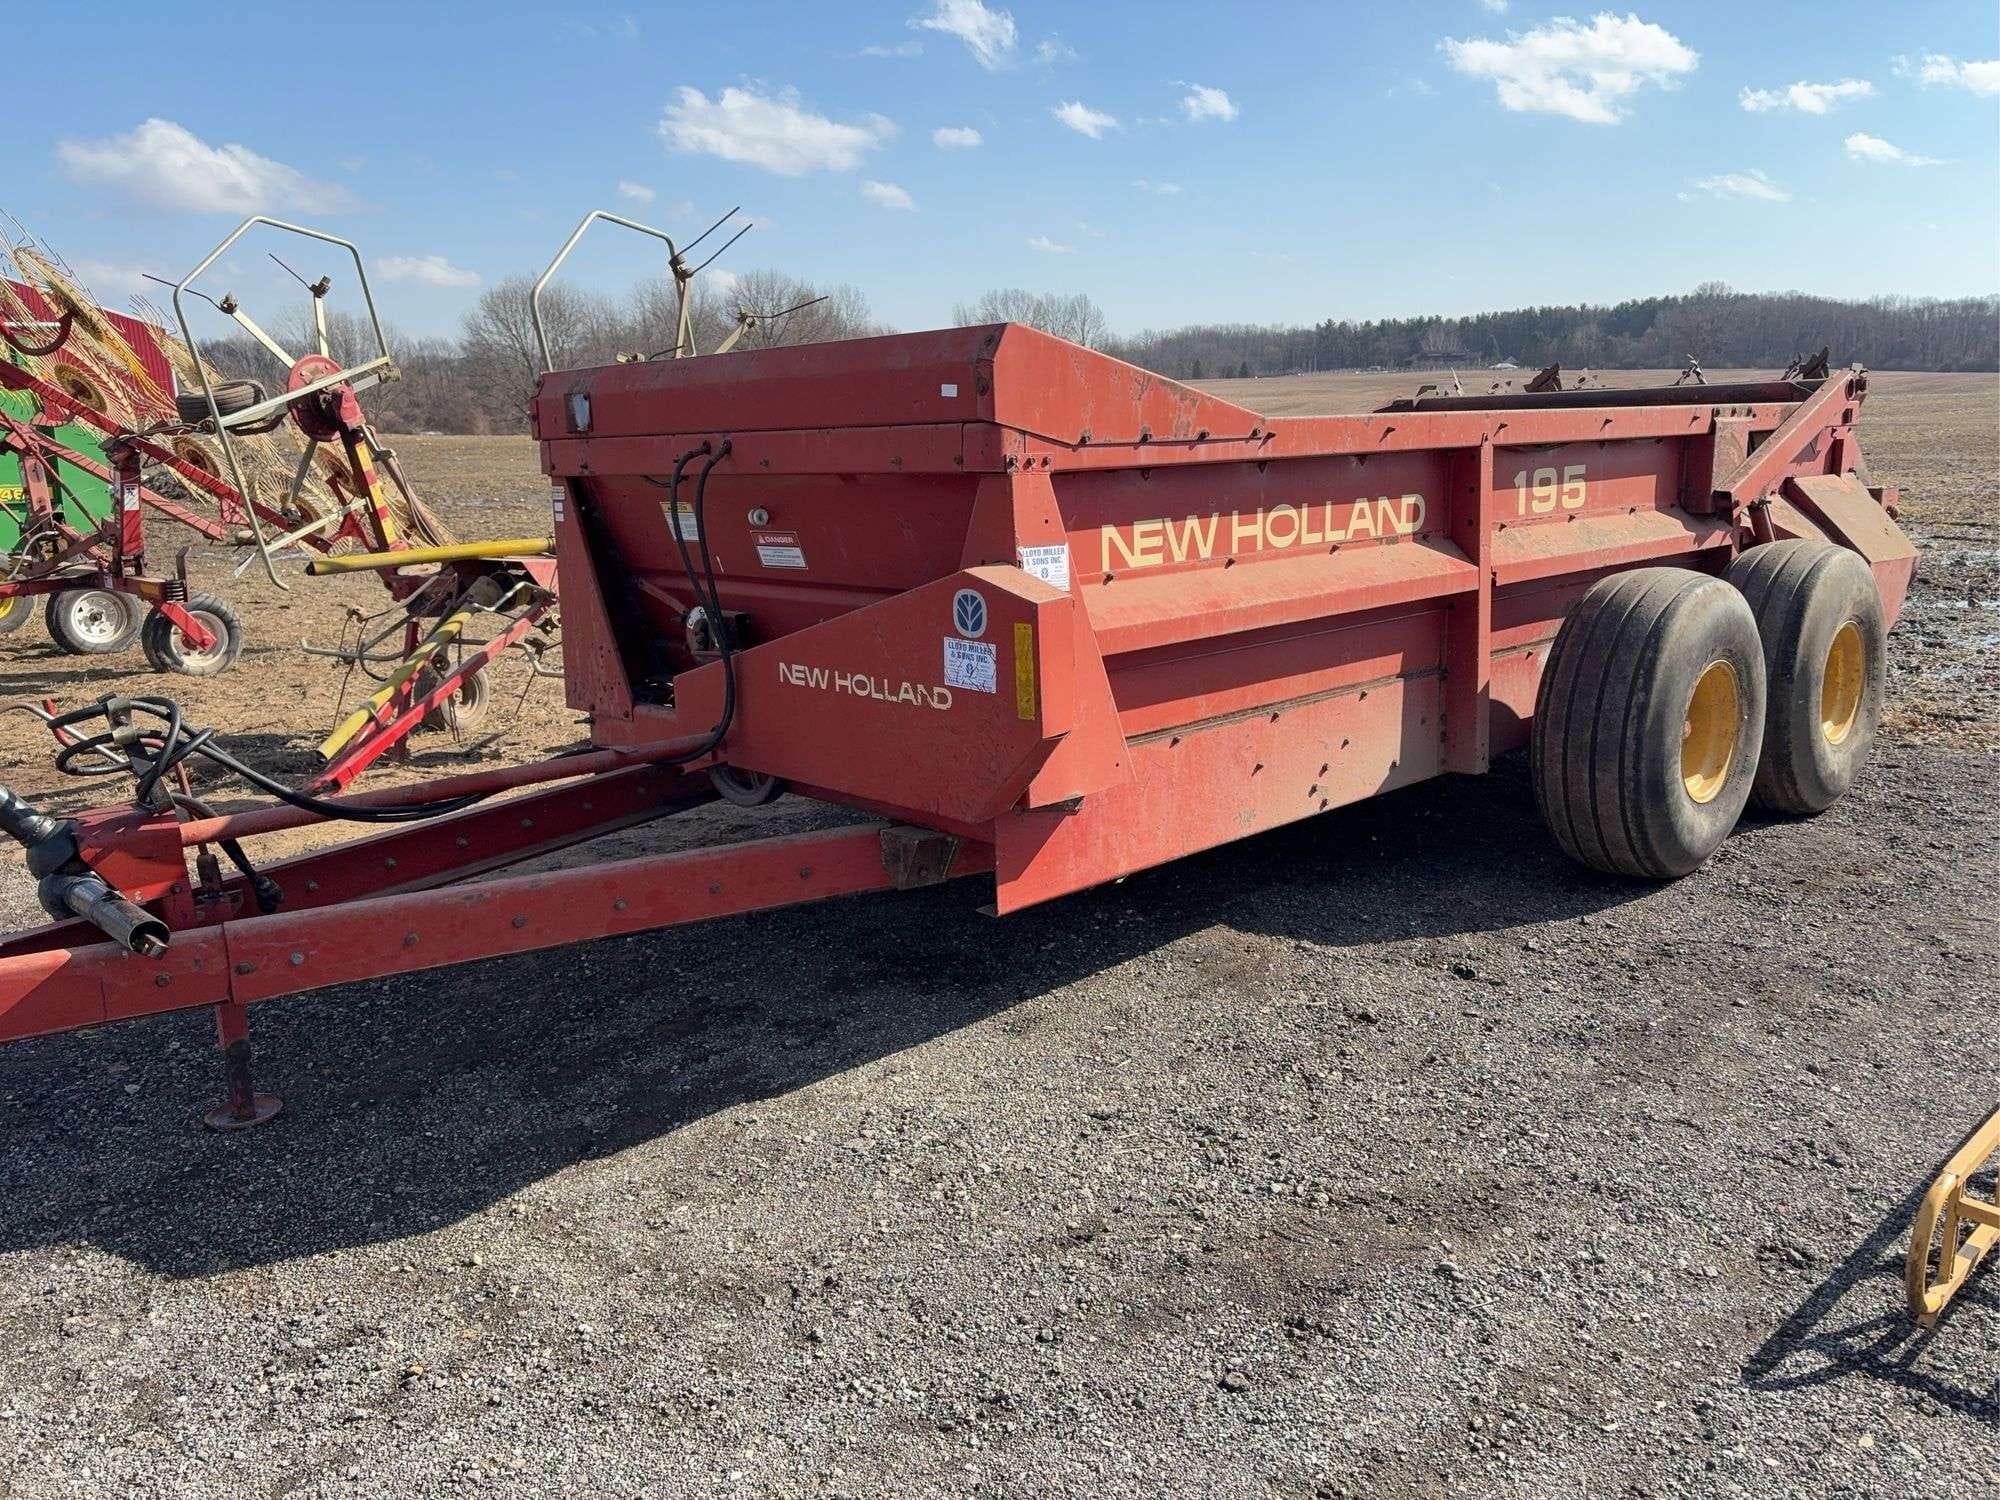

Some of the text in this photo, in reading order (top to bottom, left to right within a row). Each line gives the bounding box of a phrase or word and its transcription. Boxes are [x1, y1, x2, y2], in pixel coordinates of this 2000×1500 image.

[1513, 464, 1586, 516] 195
[1101, 494, 1426, 572] NEW HOLLAND
[765, 536, 794, 544] DANGER
[1043, 547, 1065, 556] MILLER
[1032, 556, 1049, 565] SONS
[948, 641, 992, 655] LLOYD MILLER
[957, 651, 975, 662] SONS
[779, 662, 829, 690] NEW
[835, 671, 953, 710] HOLLAND
